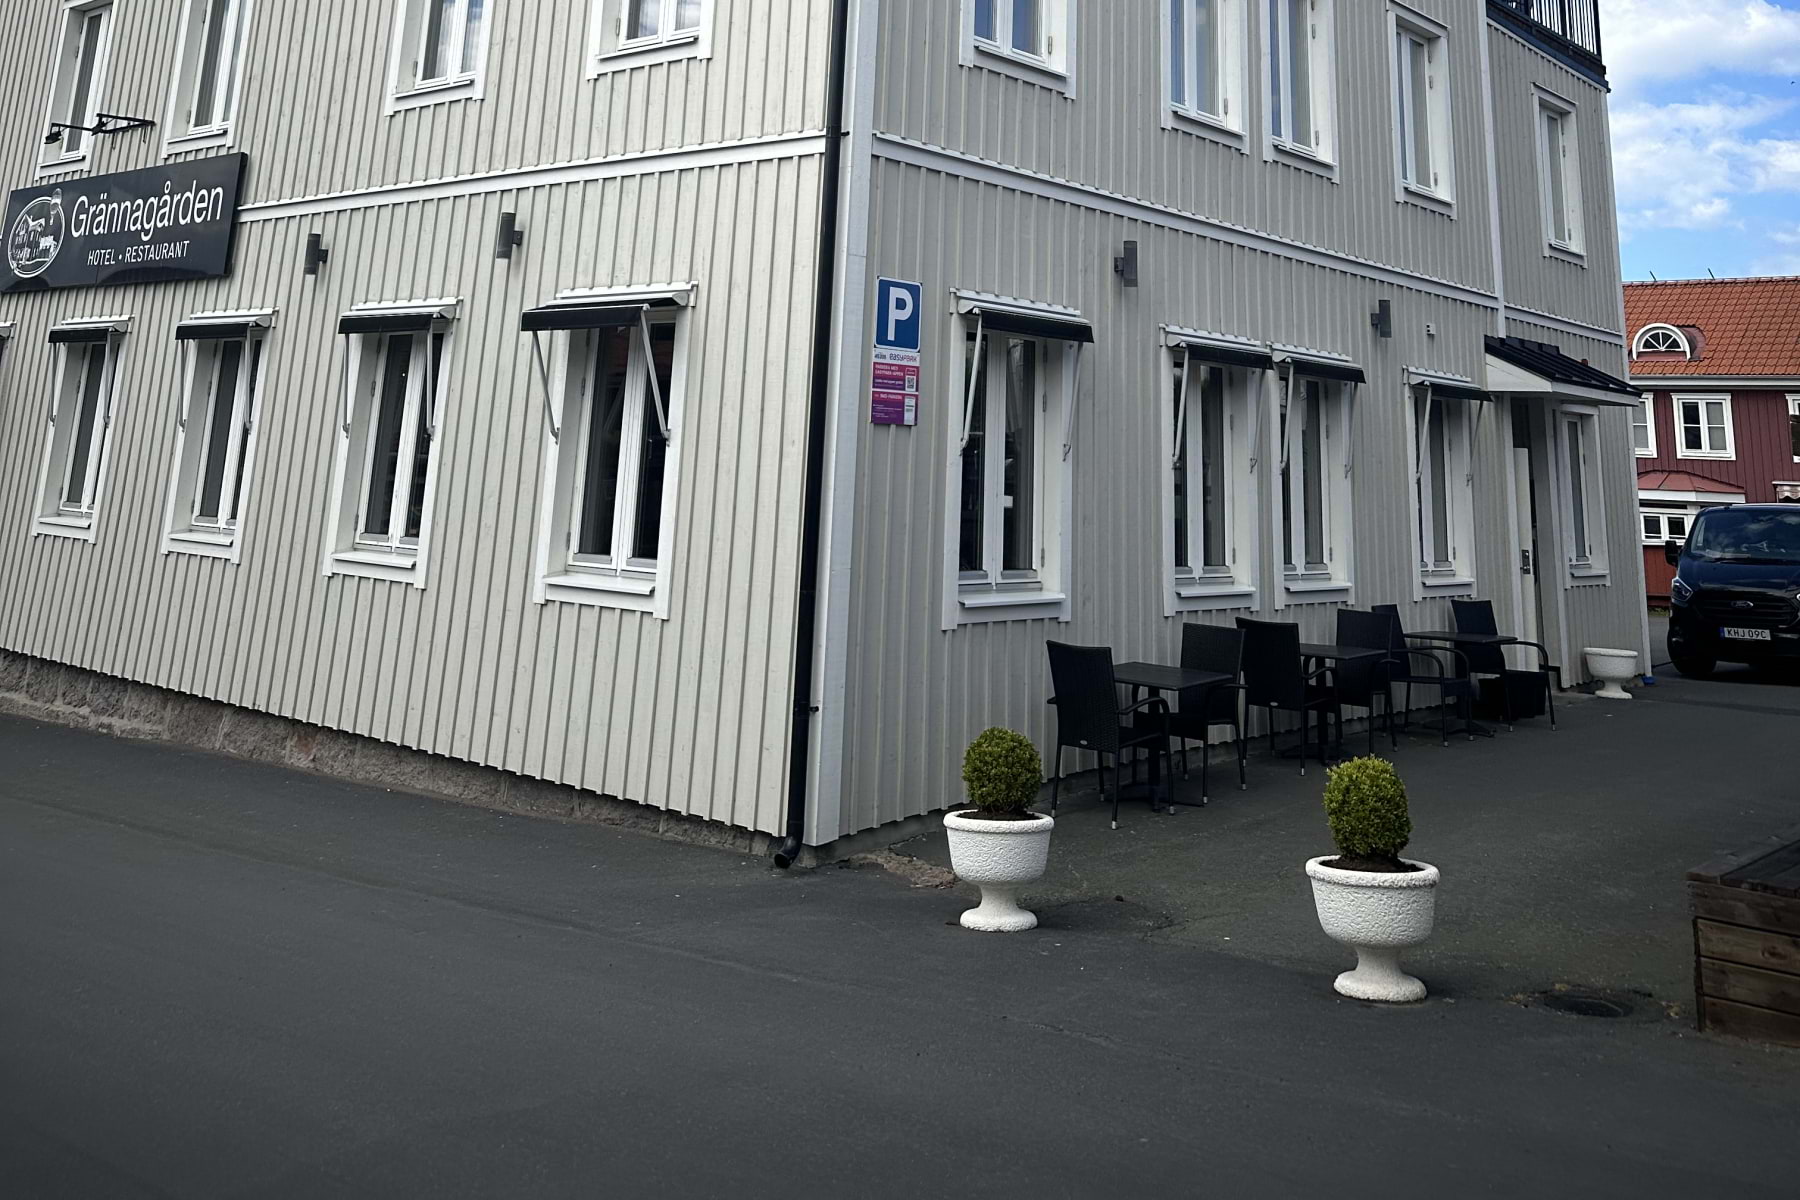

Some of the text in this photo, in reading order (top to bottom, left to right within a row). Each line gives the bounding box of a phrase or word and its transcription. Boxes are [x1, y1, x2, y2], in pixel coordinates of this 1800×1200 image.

[71, 180, 224, 241] Grännagården
[87, 240, 190, 266] HOTEL RESTAURANT
[887, 286, 914, 341] P
[1727, 628, 1746, 638] KHJ
